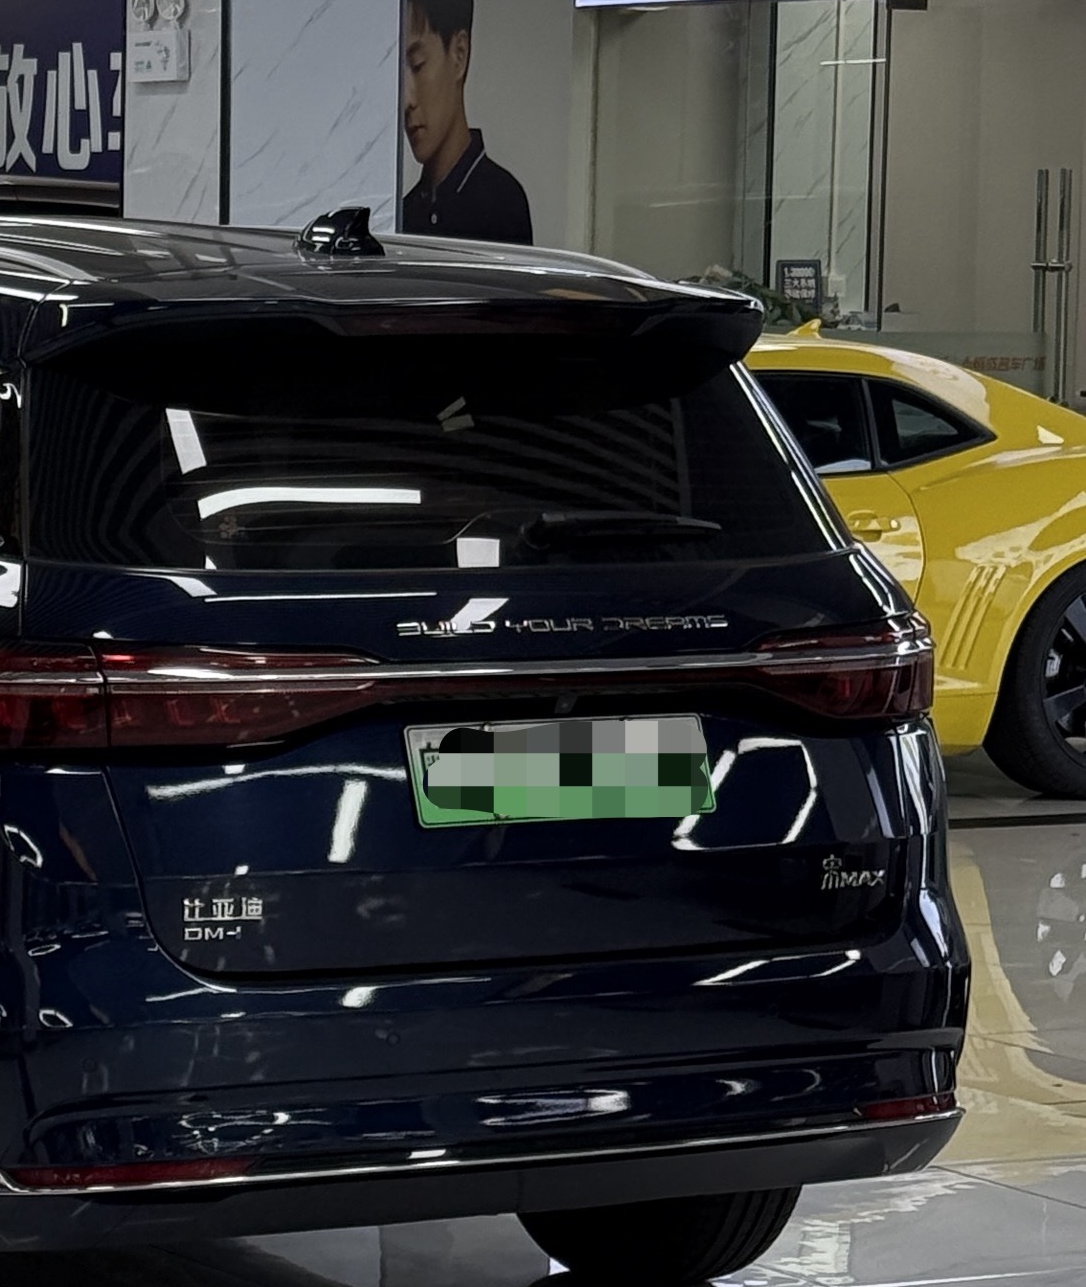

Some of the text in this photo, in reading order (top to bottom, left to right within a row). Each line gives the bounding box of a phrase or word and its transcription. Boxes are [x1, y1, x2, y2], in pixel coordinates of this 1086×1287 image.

[505, 618, 594, 632] YOUR
[601, 614, 728, 631] DREAMS
[183, 897, 263, 922] 比亚迪
